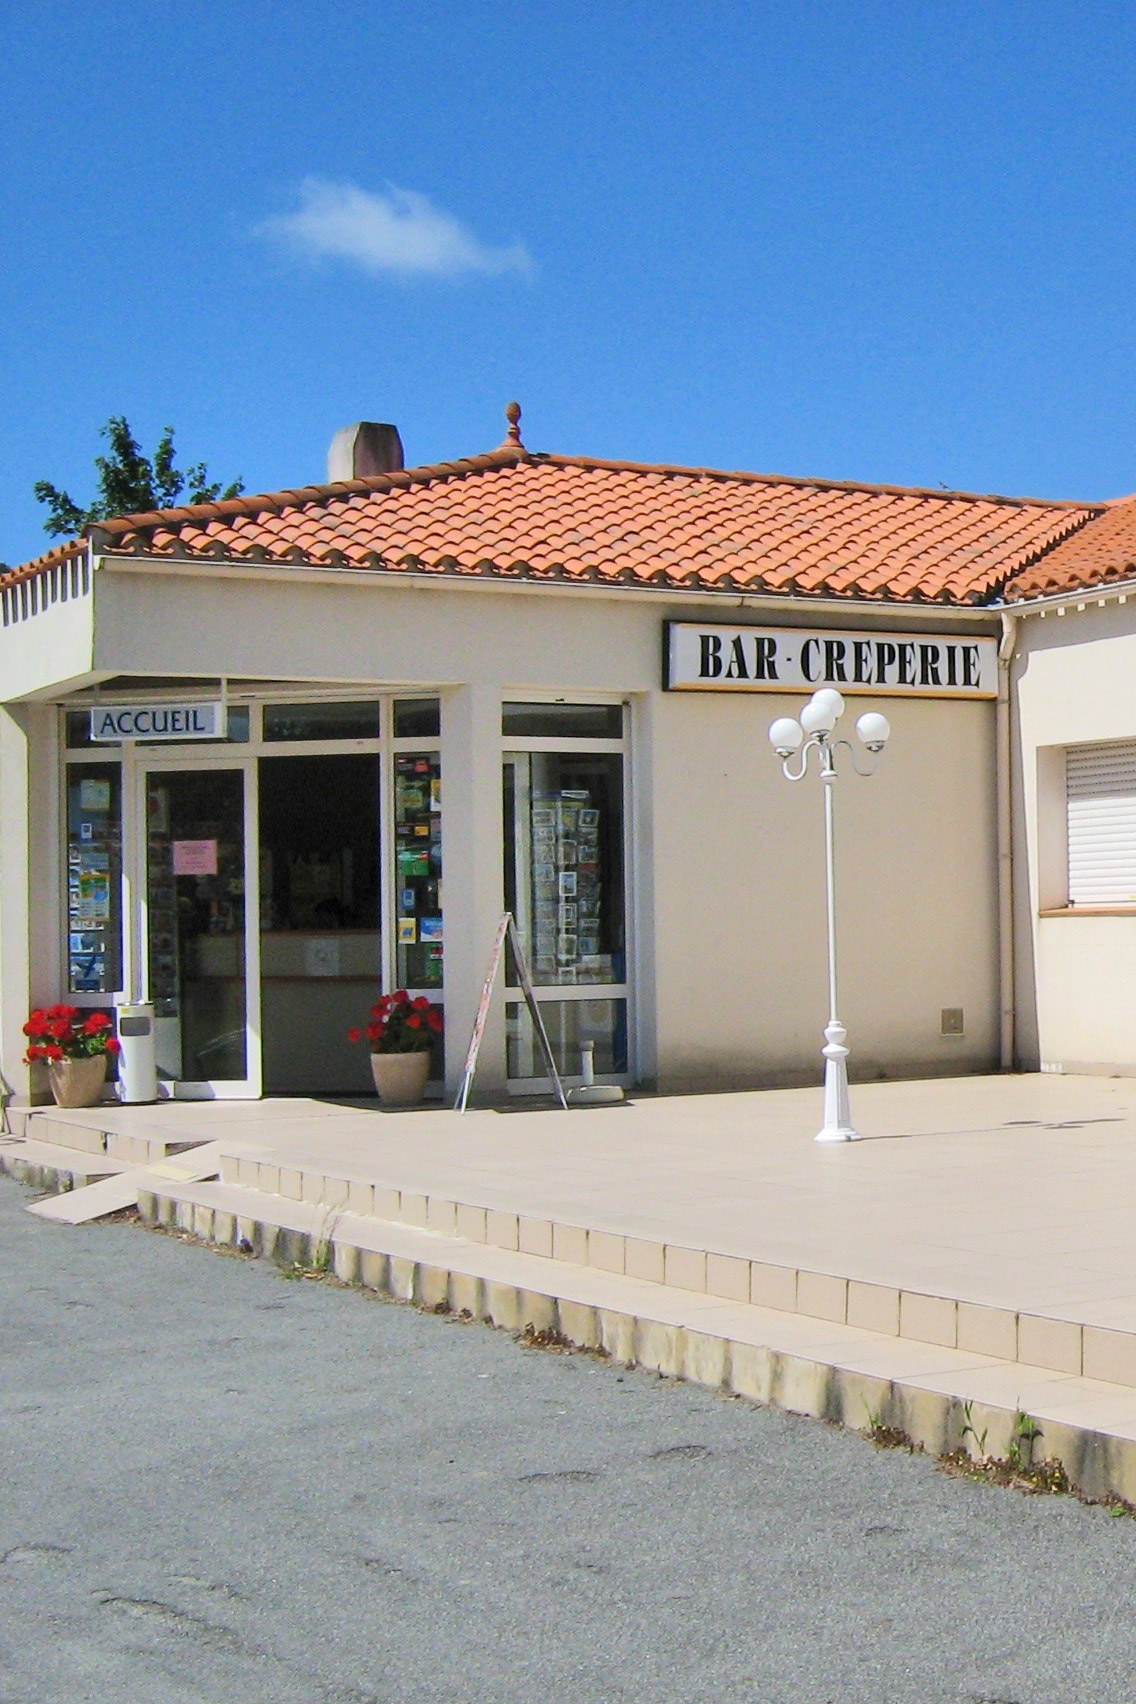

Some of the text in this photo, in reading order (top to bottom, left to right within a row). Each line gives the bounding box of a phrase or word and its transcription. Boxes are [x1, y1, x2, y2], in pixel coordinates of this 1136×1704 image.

[698, 635, 779, 679] BAR
[800, 637, 981, 689] CREPERIE
[101, 710, 205, 734] ACCUEIL
